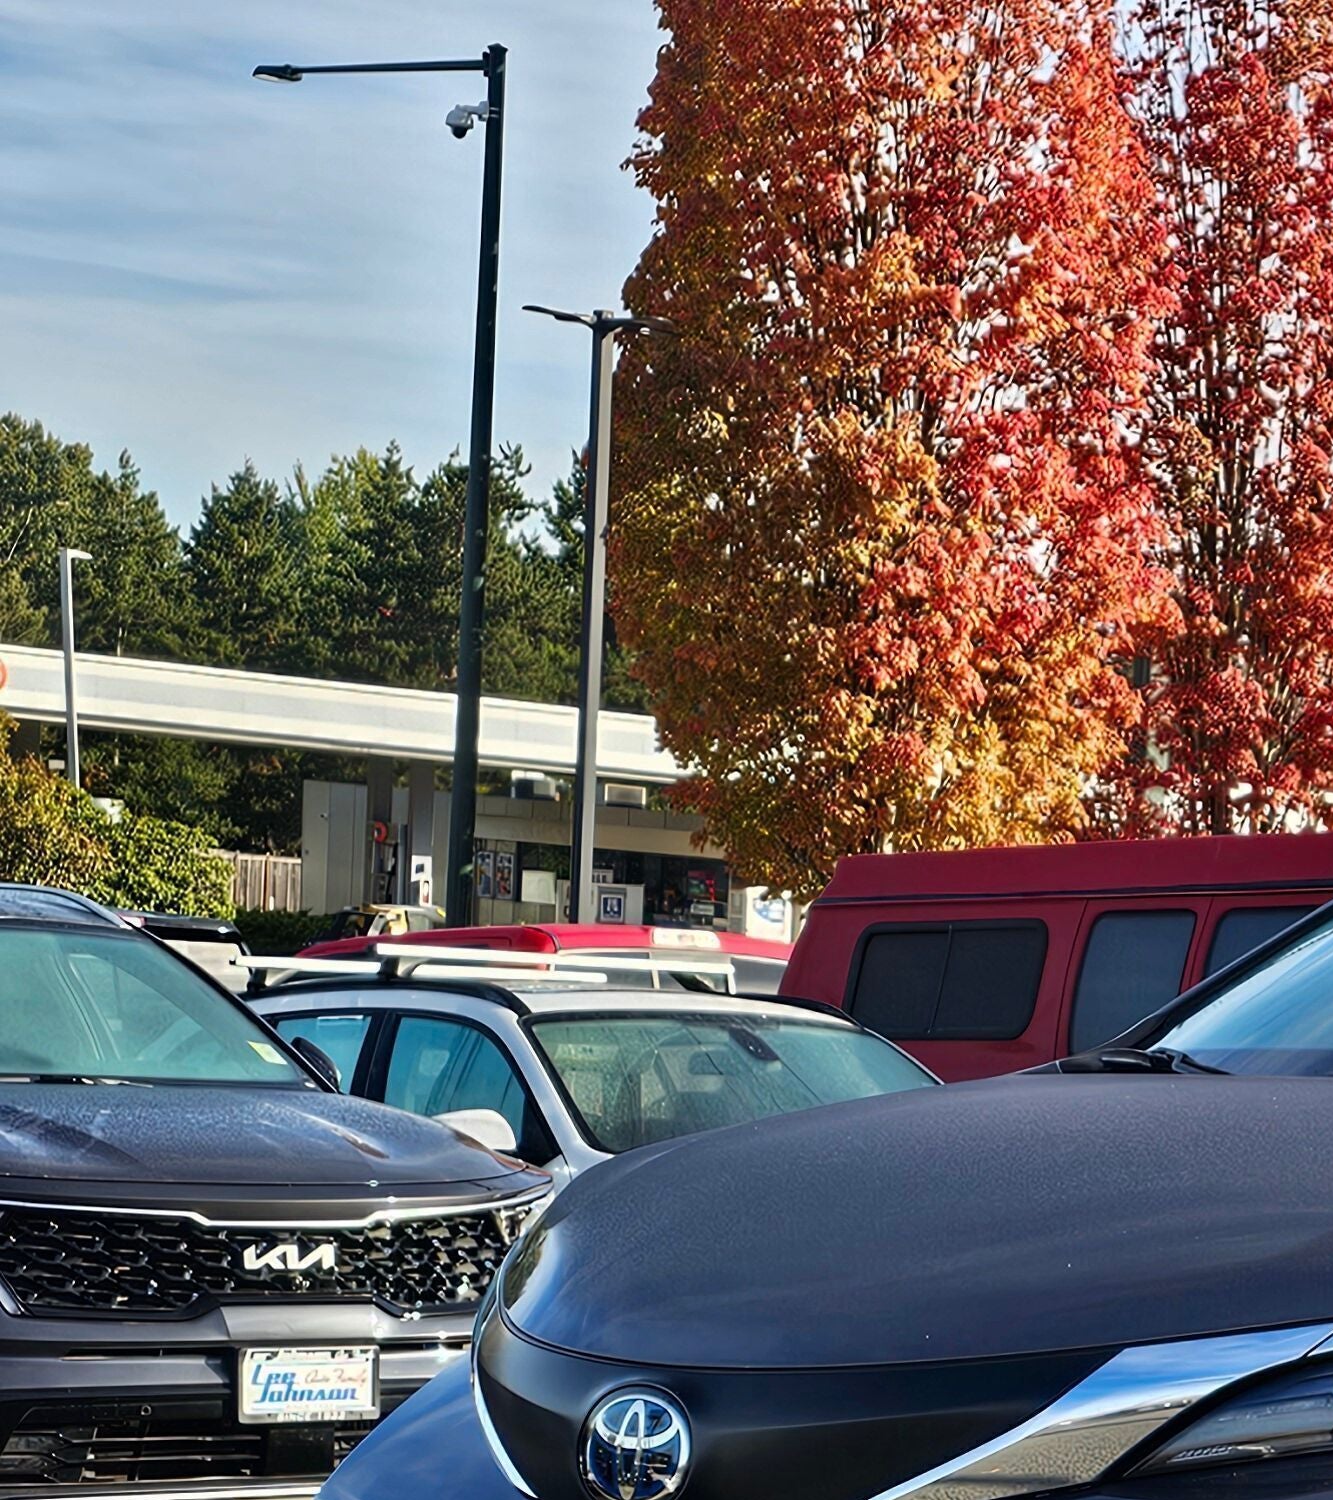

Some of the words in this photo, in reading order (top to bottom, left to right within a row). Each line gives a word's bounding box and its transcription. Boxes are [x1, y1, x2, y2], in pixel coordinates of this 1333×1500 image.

[243, 1243, 336, 1271] KIA
[251, 1364, 299, 1385] Lee
[253, 1382, 359, 1404] Johnson
